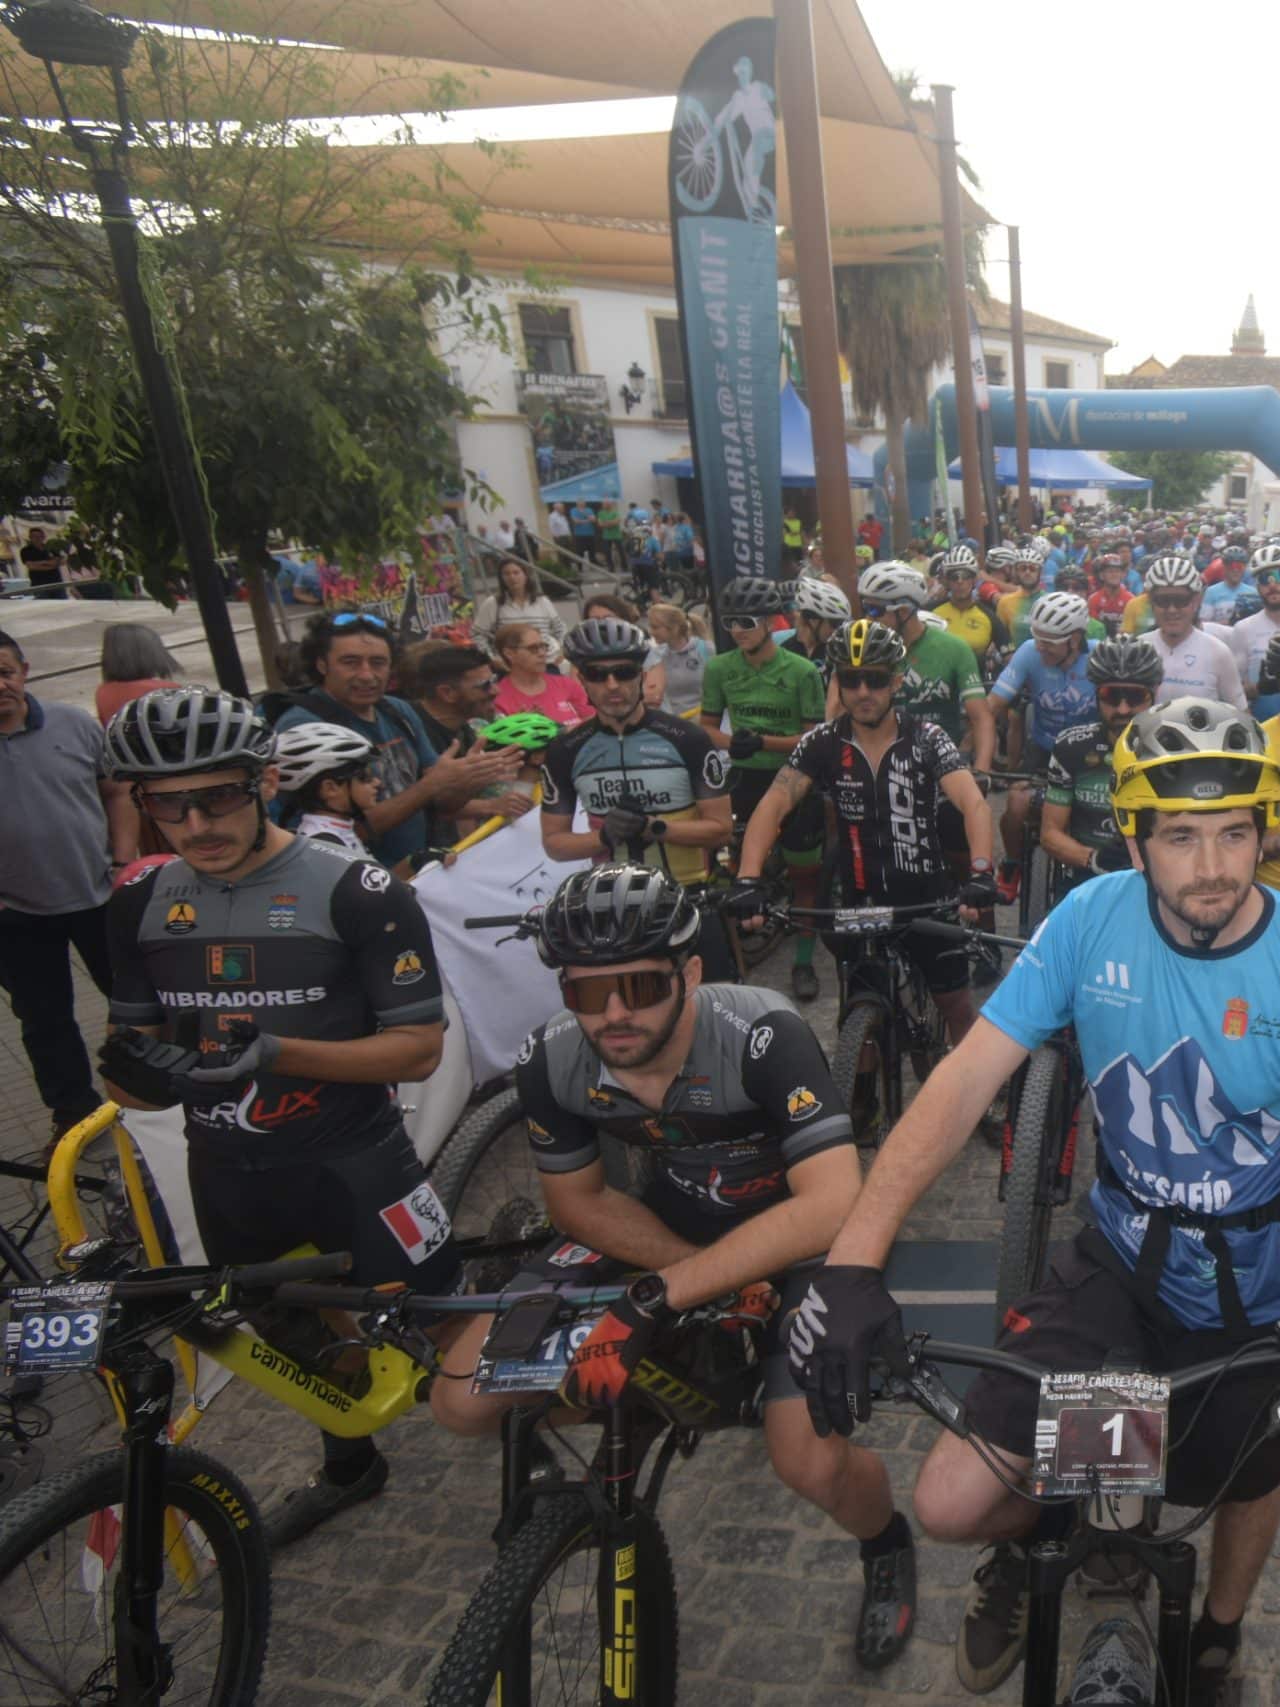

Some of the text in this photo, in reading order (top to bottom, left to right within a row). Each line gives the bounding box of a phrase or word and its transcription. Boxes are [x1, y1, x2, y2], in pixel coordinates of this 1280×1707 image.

[593, 776, 645, 795] Team
[156, 986, 327, 1009] VIBRADORES
[24, 1313, 100, 1349] 393
[249, 1340, 353, 1414] cannondale
[1102, 1412, 1124, 1457] 1
[192, 1473, 251, 1531] MAXXIS
